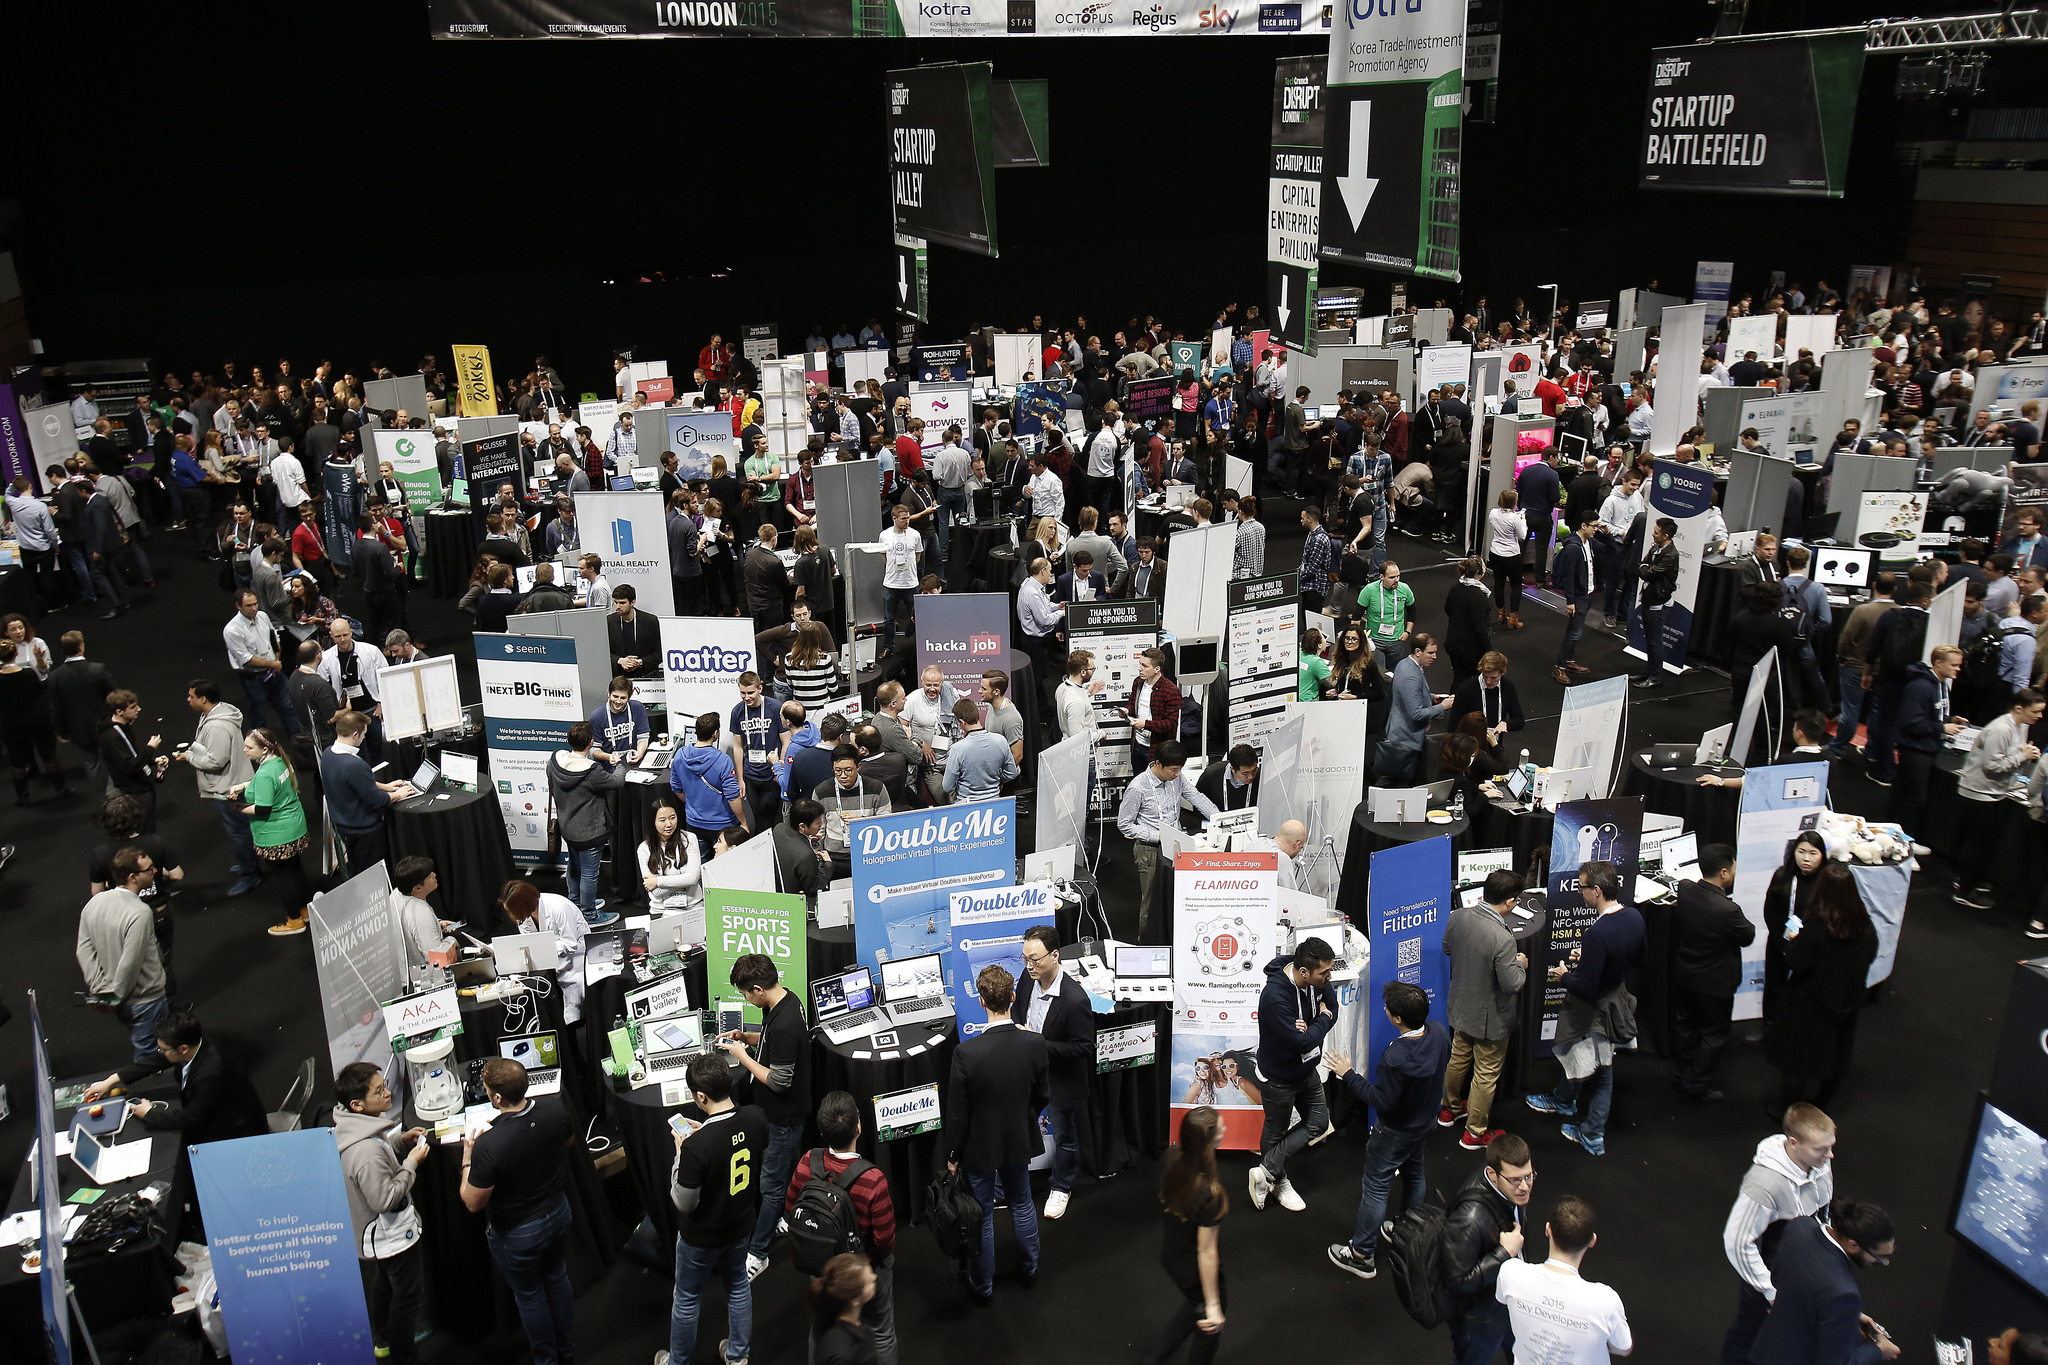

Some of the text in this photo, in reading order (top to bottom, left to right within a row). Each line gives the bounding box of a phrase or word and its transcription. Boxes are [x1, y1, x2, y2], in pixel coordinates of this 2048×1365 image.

[919, 2, 971, 18] kotra
[1273, 9, 1285, 17] ARE
[1011, 18, 1032, 27] STAR
[1055, 13, 1114, 25] OCTOPUS
[1133, 10, 1177, 32] Regus
[1199, 4, 1239, 33] sky
[1262, 18, 1277, 27] TECH
[449, 24, 488, 34] #TCDISRUPT
[548, 23, 627, 34] TECHCRUNCH.COM/EVENTS
[1349, 41, 1377, 56] Korea
[1379, 32, 1463, 53] Trade-Investment
[1348, 56, 1430, 74] Promotion Agency
[1655, 61, 1692, 78] DISRUPT
[1283, 85, 1320, 111] DISRUPT
[1650, 94, 1736, 128] STARTUP
[893, 127, 937, 166] STARTUP
[1646, 133, 1767, 166] BATTLEFIELD
[1275, 153, 1323, 174] STARTUP ALLEY
[896, 170, 923, 209] ALLEY
[1281, 184, 1316, 209] CAPITAL
[1279, 236, 1316, 262] PAVILION
[923, 349, 961, 359] ROIHUNTER
[1349, 378, 1389, 386] CHARTMOGUL
[1130, 387, 1171, 400] IMAGE RESIZING
[482, 439, 507, 451] GLISSER
[479, 451, 507, 463] WE MAKE
[471, 463, 520, 480] INTERACTIVE
[472, 457, 517, 473] PRESENTATIONS
[1672, 476, 1703, 490] YOOBIC
[604, 567, 650, 575] SHOWROOM
[626, 560, 660, 568] REALITY
[1244, 587, 1284, 601] OUR SPONSORS
[1245, 580, 1283, 594] THANK YOU TO
[1087, 614, 1138, 625] OUR SPONSORS
[1089, 606, 1136, 618] THANK YOU TO
[1263, 625, 1275, 634] esri
[516, 644, 547, 655] seenit
[925, 638, 997, 653] hacka job
[668, 646, 750, 672] natter
[1280, 650, 1291, 658] sky
[674, 675, 716, 684] short and
[1106, 682, 1125, 691] Regus
[489, 681, 572, 698] NEXT BIG THING
[862, 836, 1006, 866] Holographic Virtual Reality Experiences!
[1243, 860, 1262, 868] Enjoy.
[1469, 859, 1510, 873] Keypair
[873, 888, 881, 899] 1
[887, 886, 902, 895] Make
[902, 883, 921, 893] Instant
[922, 881, 939, 890] Virtual
[939, 878, 961, 887] Doubles
[967, 872, 995, 882] HoloPortal
[1194, 880, 1259, 890] FLAMINGO
[721, 905, 790, 917] ESSENTIAL APP FOR
[959, 907, 1046, 921] Holographic Virtual Reality Experiences!
[1382, 897, 1438, 918] Need Translations?
[1554, 907, 1571, 918] The
[721, 915, 791, 934] SPORTS
[1382, 906, 1438, 936] Flitto it!
[1551, 928, 1583, 939] HSM &
[722, 931, 792, 958] FANS
[1208, 981, 1261, 990] flamingofly.com
[650, 985, 682, 1003] breeze
[402, 1000, 441, 1021] AKA
[653, 995, 679, 1012] valley
[397, 1012, 448, 1032] BE THE CHANGE
[1100, 1039, 1139, 1051] FLAMINGO
[731, 1131, 745, 1147] BO
[730, 1148, 751, 1196] 6
[256, 1213, 299, 1228] To help
[214, 1221, 344, 1247] better communication
[228, 1233, 338, 1257] between all things
[258, 1249, 311, 1264] including
[246, 1258, 330, 1278] human beings
[1541, 1295, 1566, 1310] 2015
[1516, 1299, 1589, 1331] Sky Developers
